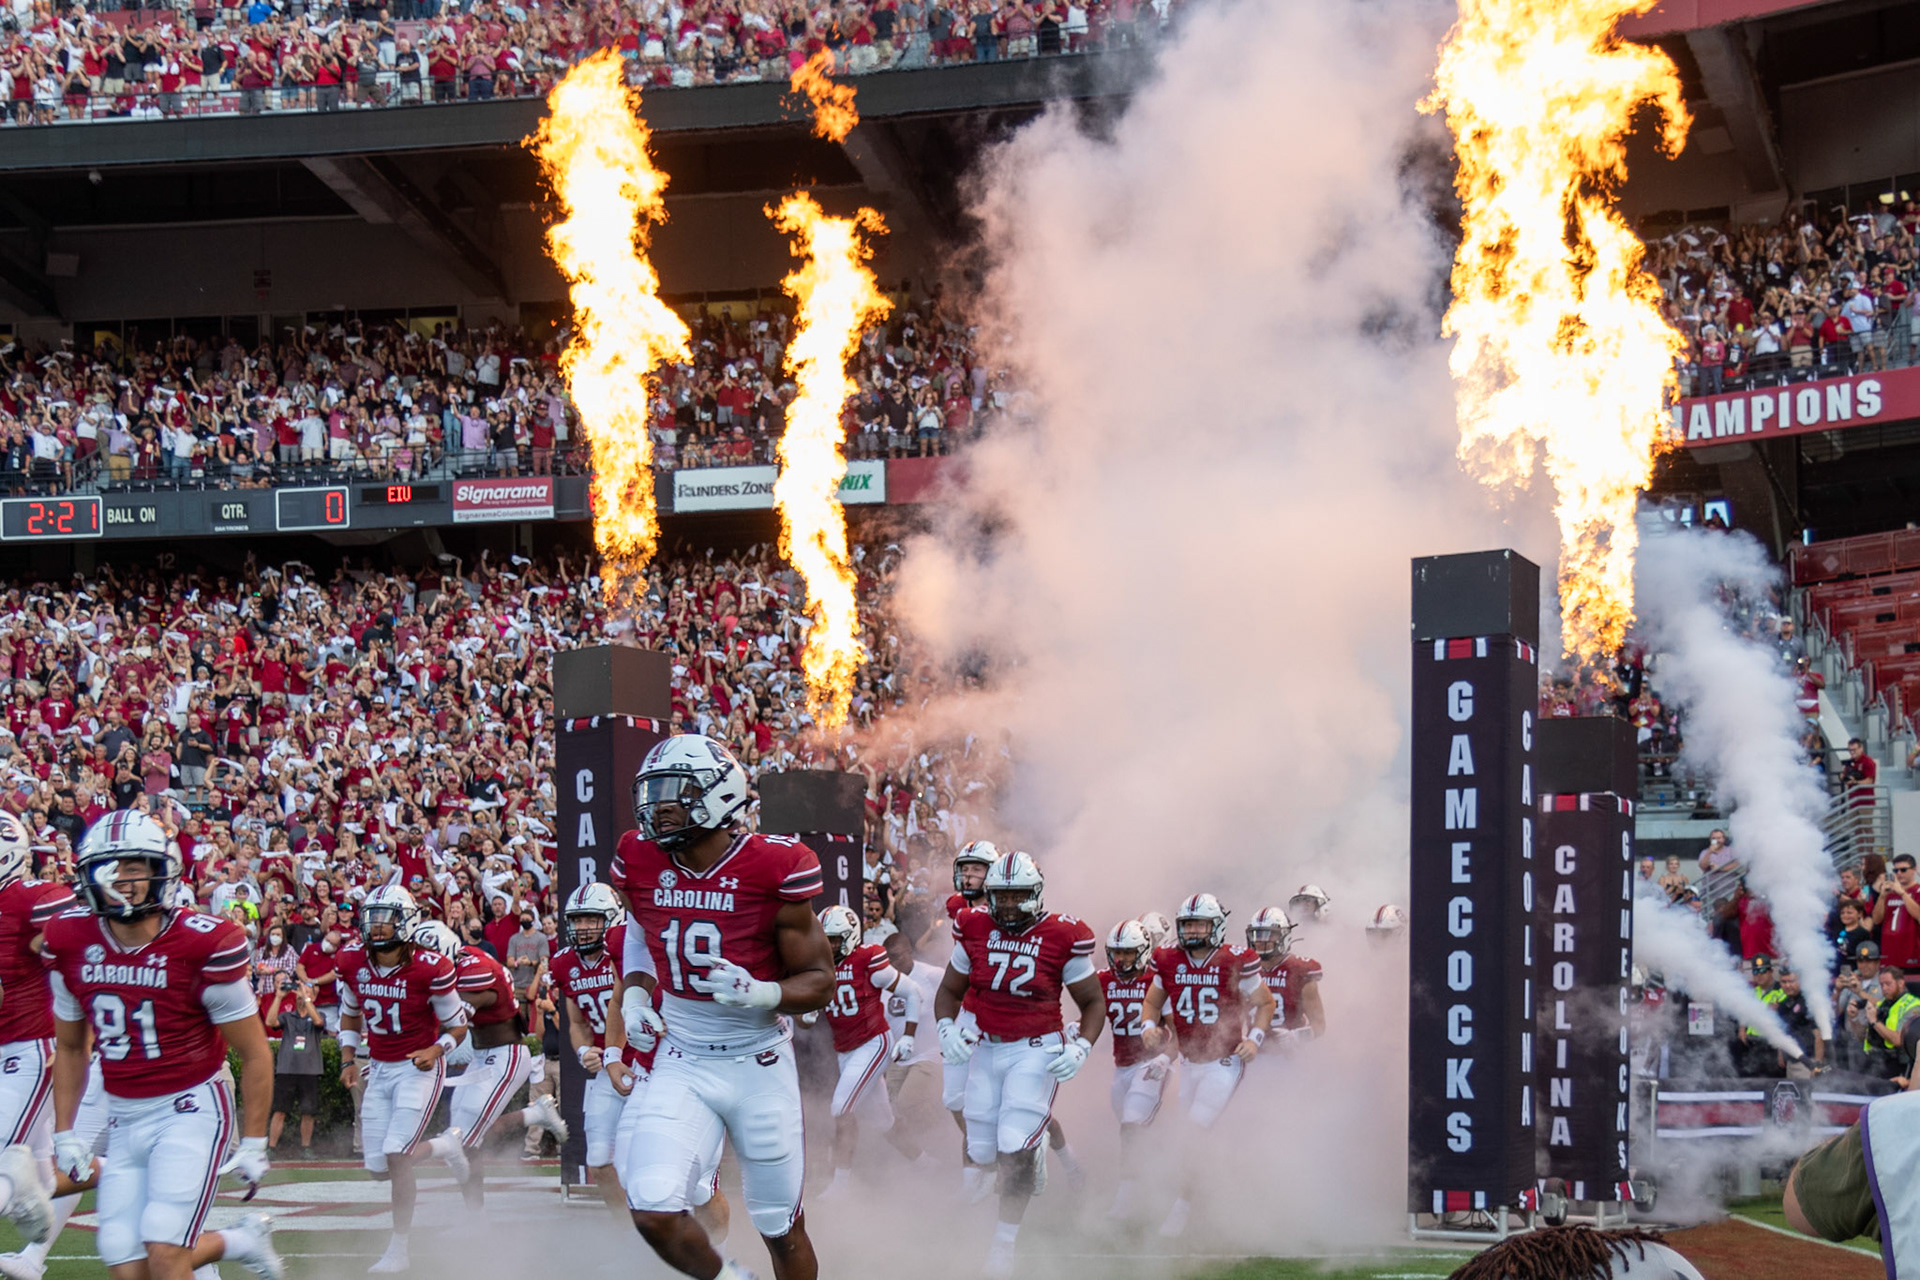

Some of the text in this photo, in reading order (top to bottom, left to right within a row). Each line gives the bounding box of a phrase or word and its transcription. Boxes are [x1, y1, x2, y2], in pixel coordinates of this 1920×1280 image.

[678, 484, 739, 498] FOUNDERS
[840, 474, 873, 490] NIX
[456, 485, 548, 504] Signarama
[28, 502, 97, 533] 2:21
[107, 507, 155, 523] BALL ON
[221, 504, 247, 519] QTR.
[326, 491, 343, 523] 0
[157, 552, 175, 569] 12
[654, 888, 735, 912] CAROLINA
[1445, 681, 1476, 1152] GAMECOCKS
[1521, 710, 1532, 1126] CAROLINA
[660, 918, 722, 995] 19
[987, 940, 1040, 957] CAROLINA
[81, 964, 167, 989] CAROLINA
[569, 974, 615, 991] CAROLINA
[988, 952, 1036, 997] 72
[1175, 973, 1219, 986] CAROLINA
[358, 983, 407, 999] CAROLINA
[1107, 988, 1145, 999] CAROLINA
[1551, 845, 1575, 1147] CAROLINA
[1617, 830, 1630, 1170] GAMECOCKS
[364, 998, 402, 1034] 21
[1176, 986, 1219, 1024] 46
[1108, 1001, 1143, 1036] 22
